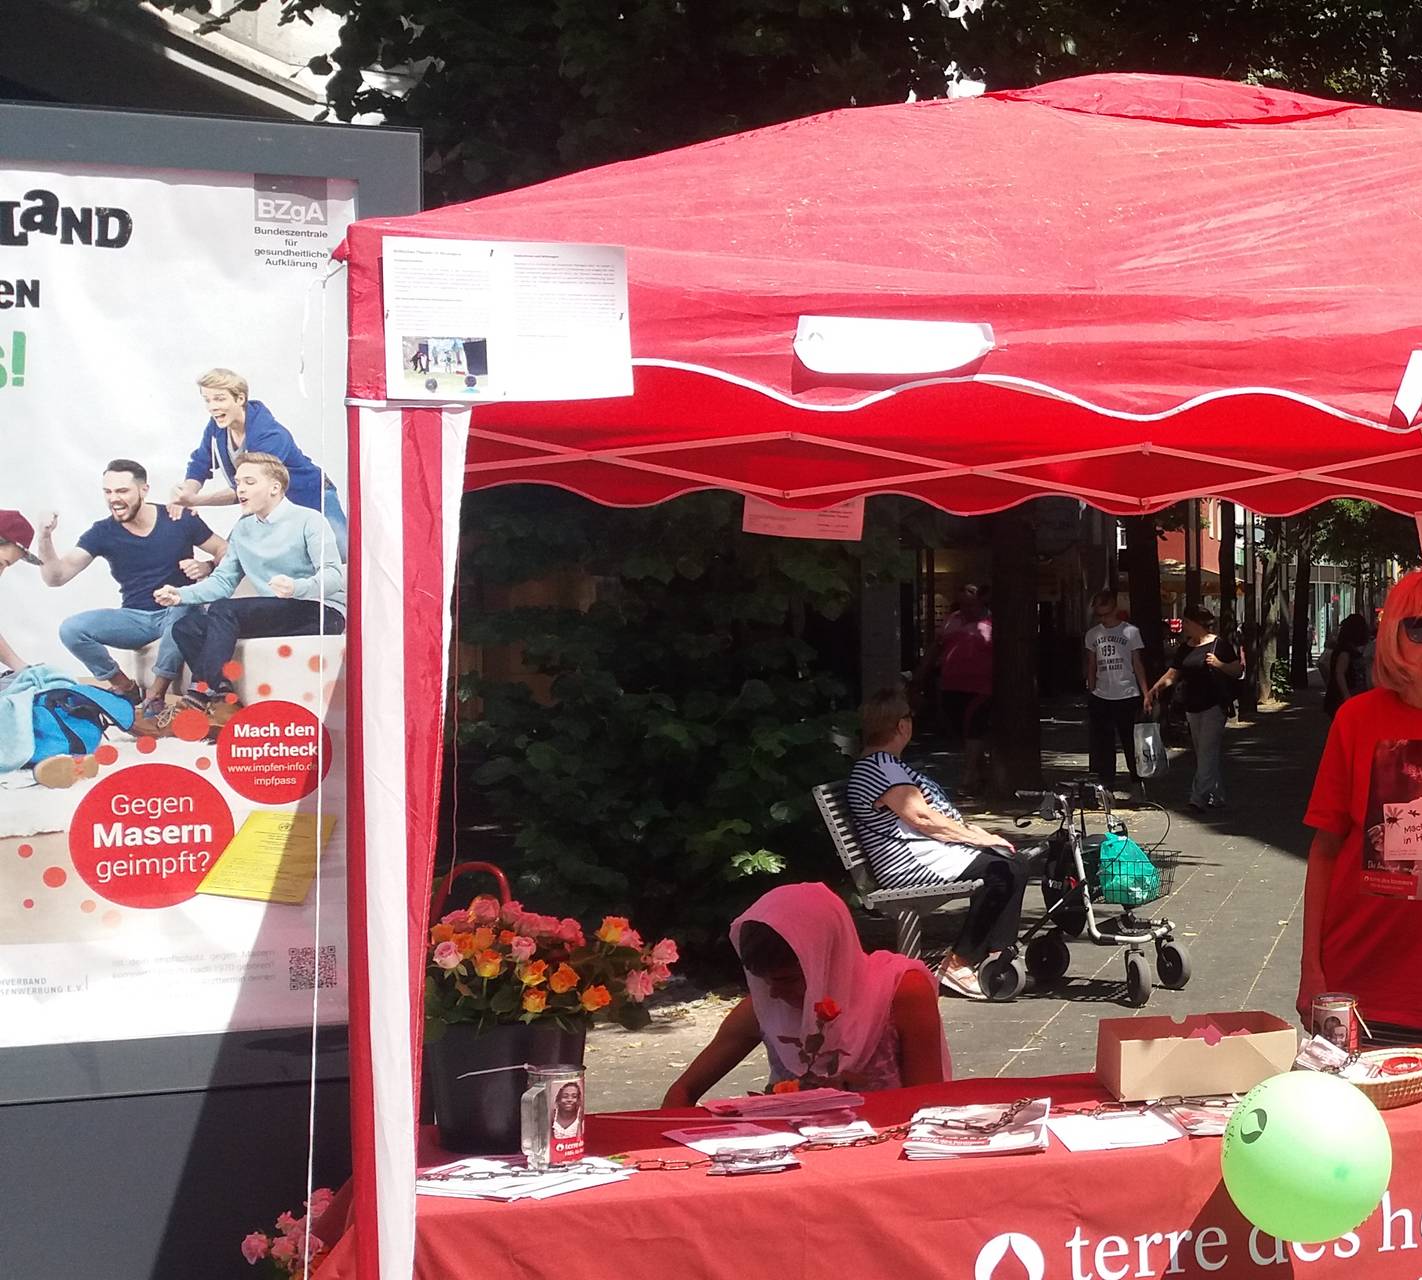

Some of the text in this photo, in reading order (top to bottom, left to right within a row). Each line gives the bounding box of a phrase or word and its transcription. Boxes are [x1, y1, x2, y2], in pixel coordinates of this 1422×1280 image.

[258, 198, 324, 224] BZgA
[254, 226, 328, 239] Bundeszentrale
[284, 239, 298, 247] für
[254, 248, 328, 259] gesundheitliche
[265, 258, 318, 270] Aufklärung
[234, 722, 315, 738] Mach den
[231, 742, 318, 761] Impfcheck
[254, 777, 297, 787] impfpass
[111, 794, 193, 820] Gegen
[93, 822, 213, 849] Masern
[1403, 837, 1412, 845] in
[96, 851, 210, 883] geimpft?
[1065, 1222, 1228, 1280] terre
